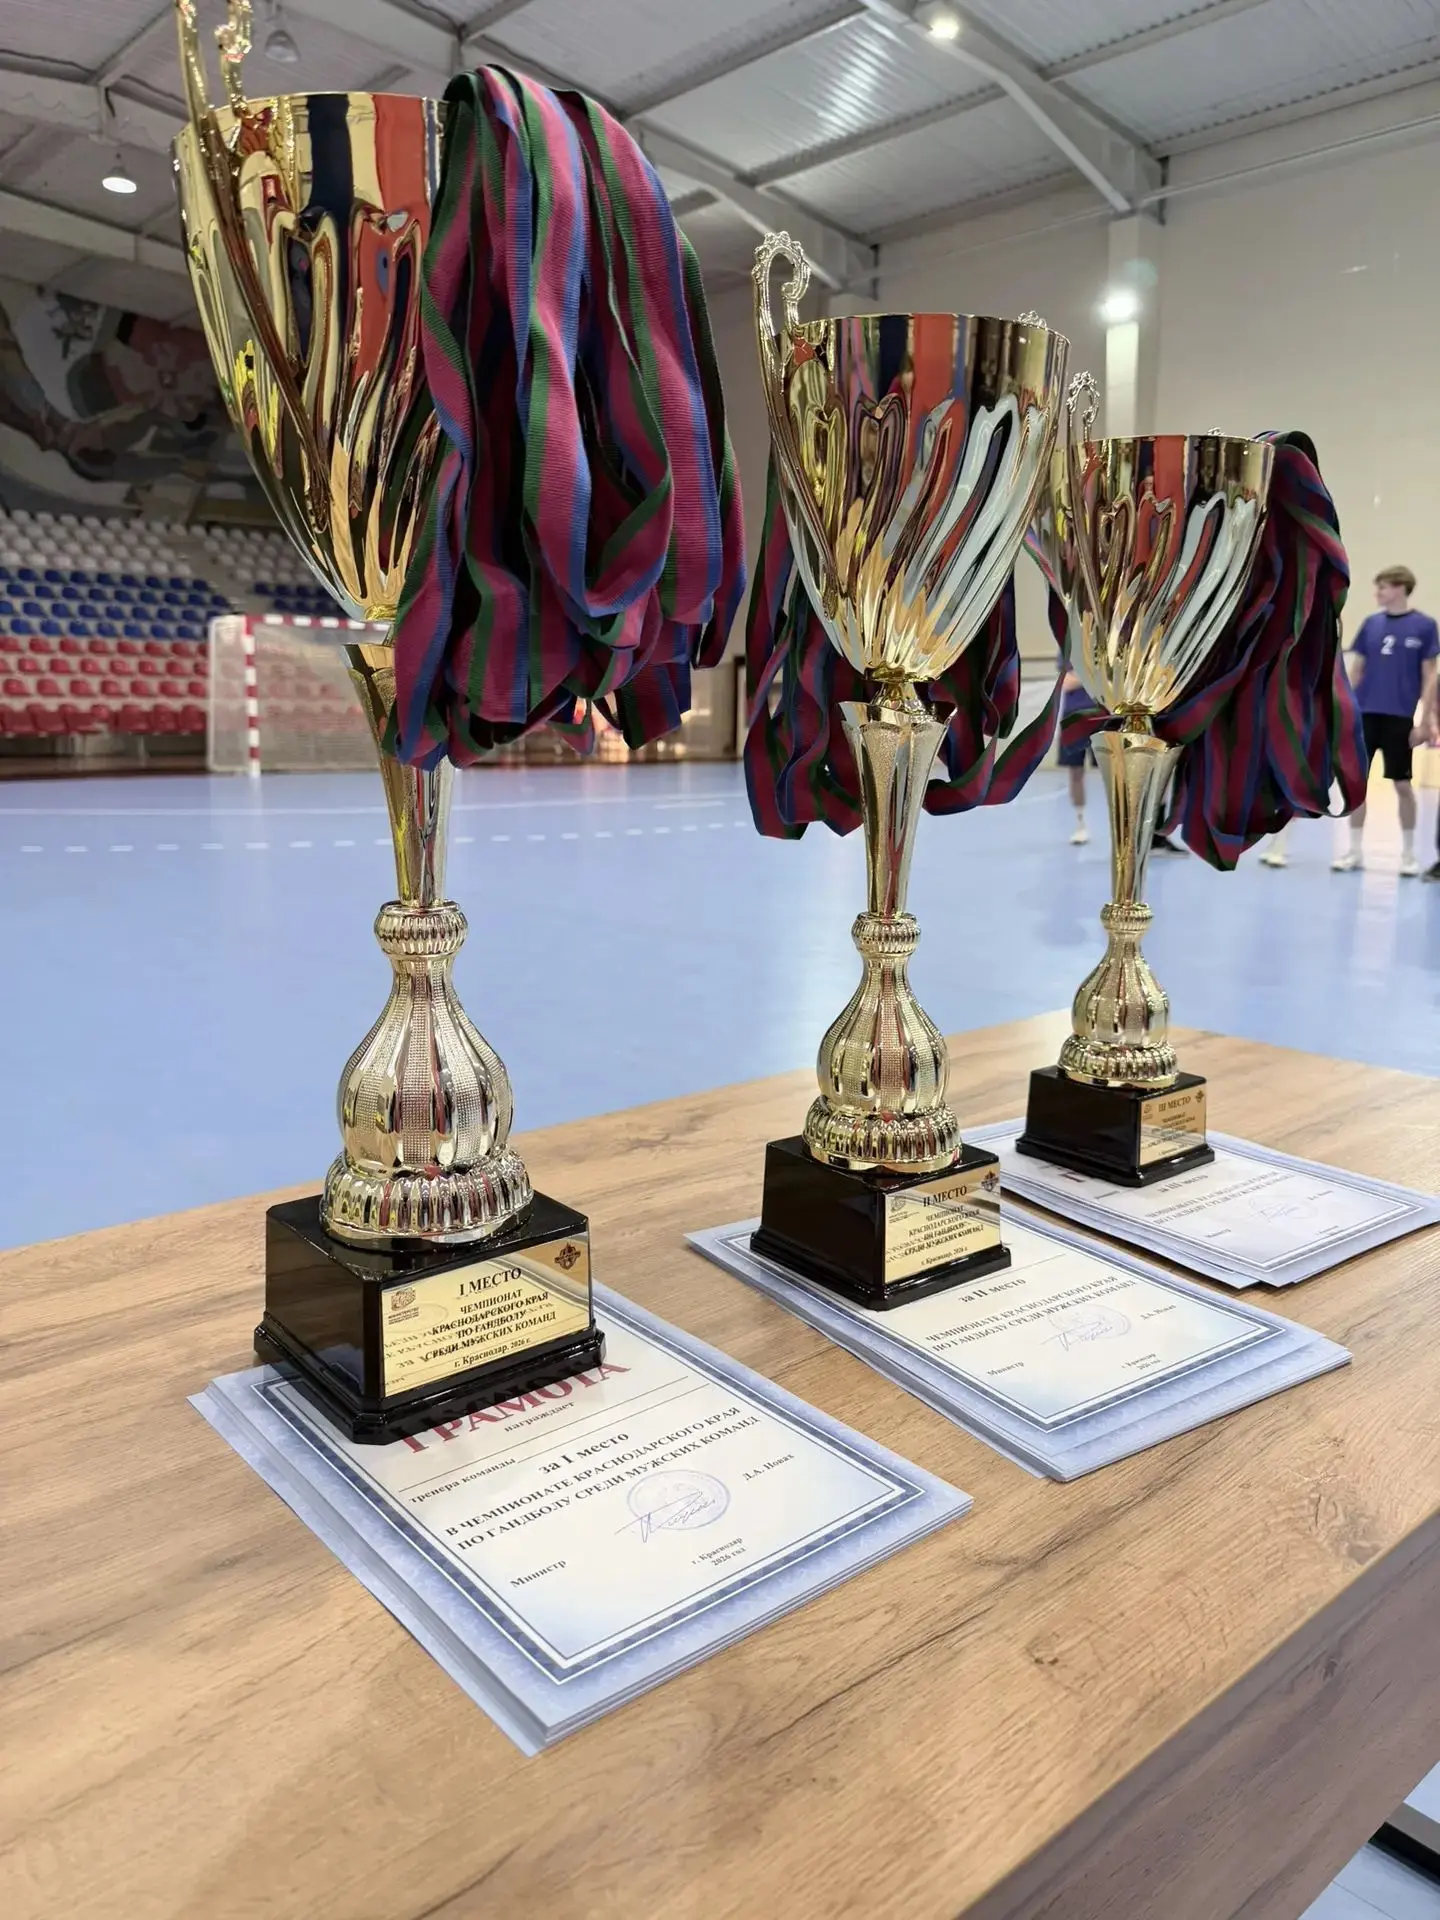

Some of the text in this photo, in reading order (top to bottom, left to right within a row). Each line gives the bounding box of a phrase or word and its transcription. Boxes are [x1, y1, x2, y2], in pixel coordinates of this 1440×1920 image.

[1381, 634, 1397, 655] 2
[1167, 1096, 1192, 1109] МЕСТО
[931, 1186, 968, 1203] МЕСТО
[459, 1267, 521, 1296] I МЕСТО
[973, 1289, 988, 1297] II
[988, 1278, 1026, 1293] место
[432, 1300, 524, 1336] КРАСНОДАРСКОГО
[525, 1291, 549, 1306] КРАЯ
[460, 1289, 522, 1315] ЧЕМПИОНАТ
[925, 1314, 1002, 1342] ЧЕМПИОНАТЕ
[1000, 1283, 1092, 1319] КРАСНОДАРСКОГО
[425, 1342, 459, 1361] СРЕДИ
[461, 1325, 513, 1349] МУЖСКИХ
[515, 1311, 557, 1331] КОМАНД
[457, 1309, 526, 1339] ПО ГАНДБОЛУ
[951, 1323, 1008, 1347] ГАНДБОЛУ
[1008, 1311, 1044, 1327] СРЕДИ
[454, 1360, 461, 1368] г.
[511, 1338, 525, 1349] 2026
[505, 1401, 575, 1432] награждает
[539, 1433, 629, 1475] за I место
[409, 1458, 516, 1504] тренера команды
[445, 1526, 459, 1537] В
[460, 1478, 573, 1529] ЧЕМПИОНАТЕ
[572, 1422, 705, 1483] КРАСНОДАРСКОГО
[704, 1406, 742, 1426] КРАЯ
[456, 1415, 761, 1551] ПО ГАНДБОЛУ СРЕДИ МУЖСКИХ КОМАНД
[699, 1537, 743, 1562] Краснодар
[711, 1553, 731, 1567] 2026
[510, 1559, 567, 1588] Министр
